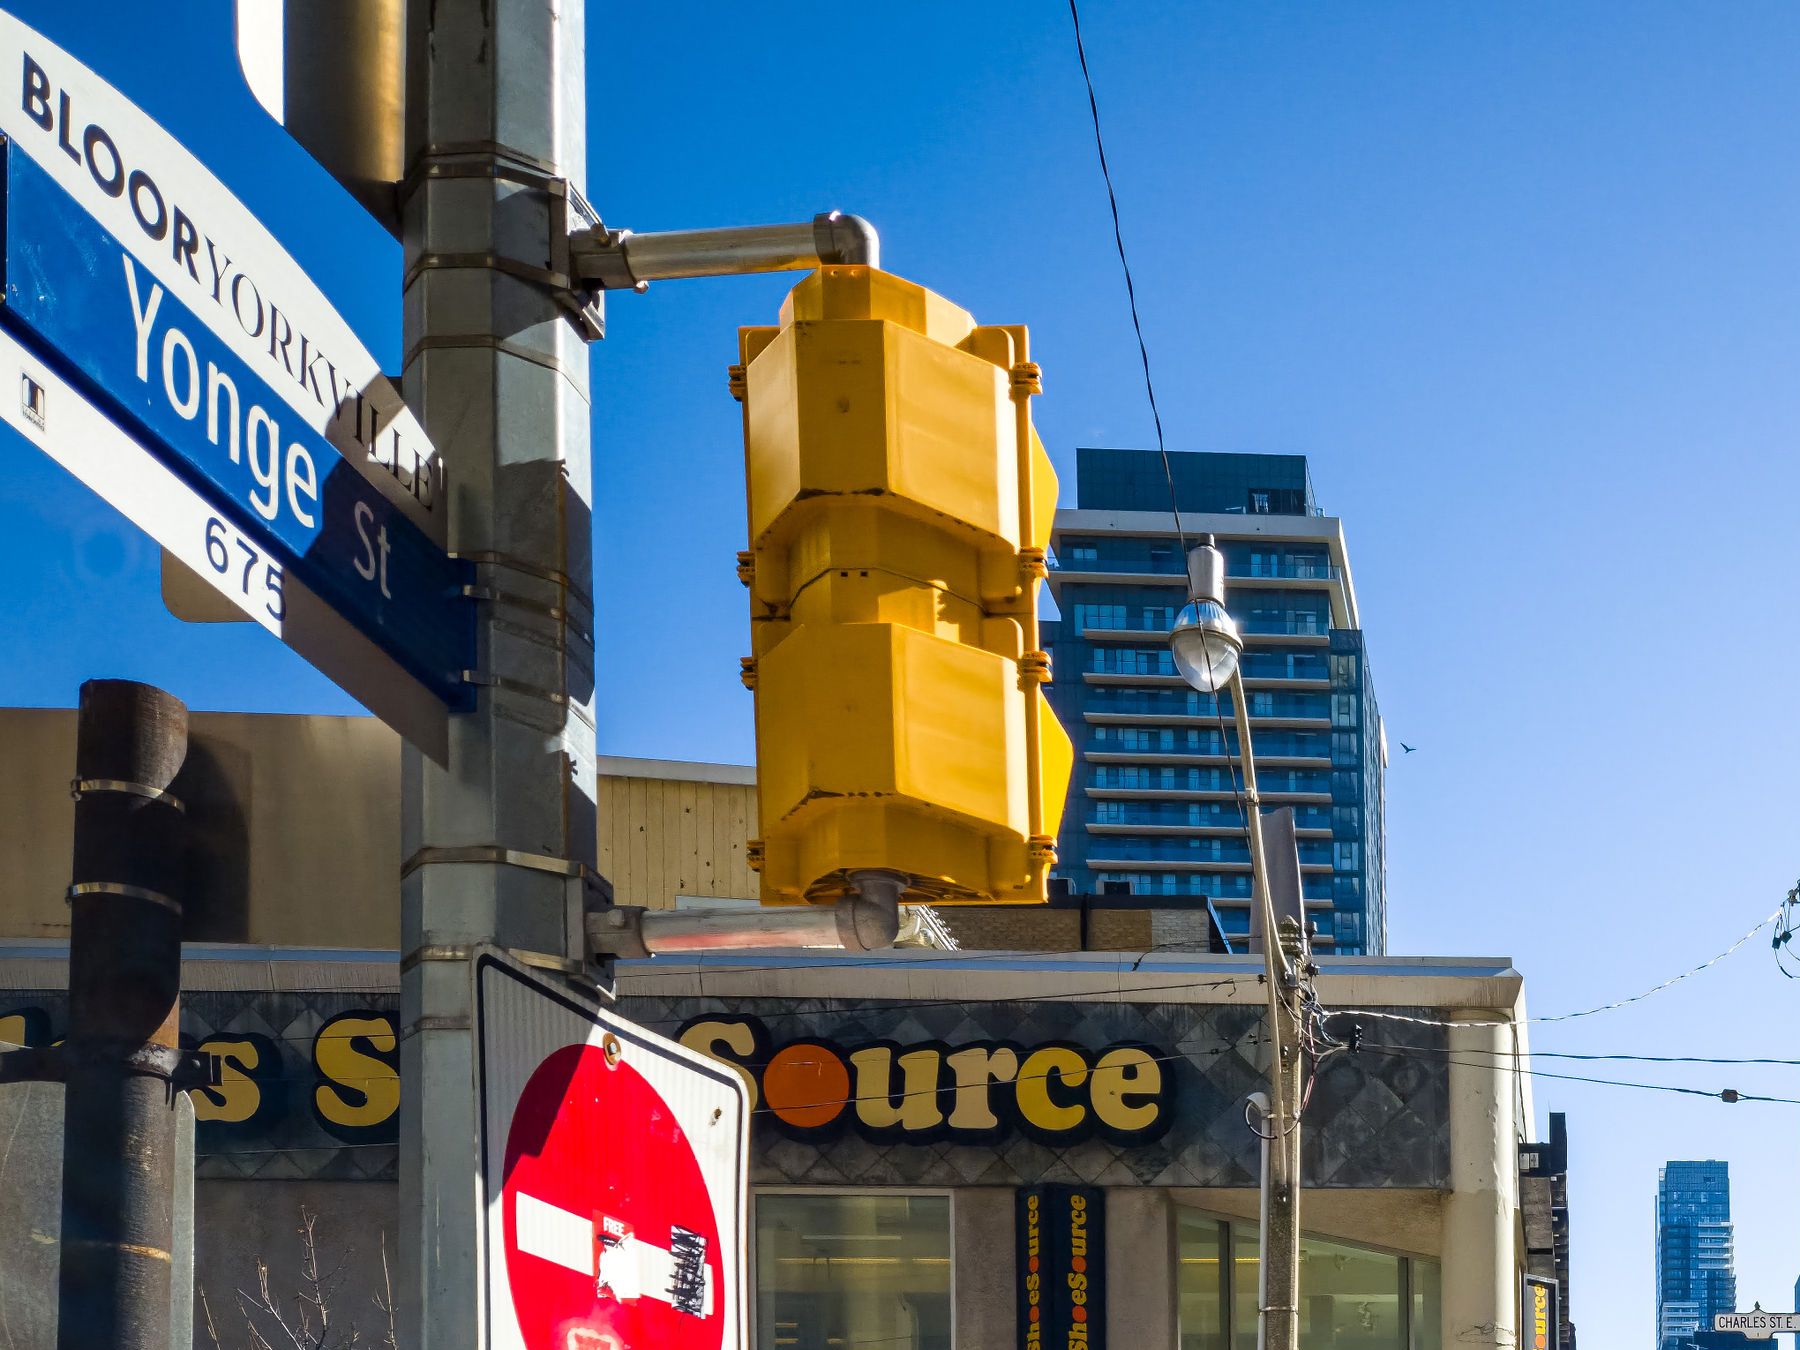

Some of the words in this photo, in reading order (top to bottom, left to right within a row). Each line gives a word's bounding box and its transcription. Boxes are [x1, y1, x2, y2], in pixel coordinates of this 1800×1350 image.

[122, 254, 318, 528] Yonge
[353, 501, 392, 600] St
[205, 516, 288, 622] 675
[603, 1216, 624, 1236] FREE
[1718, 1316, 1766, 1328] CHARLES
